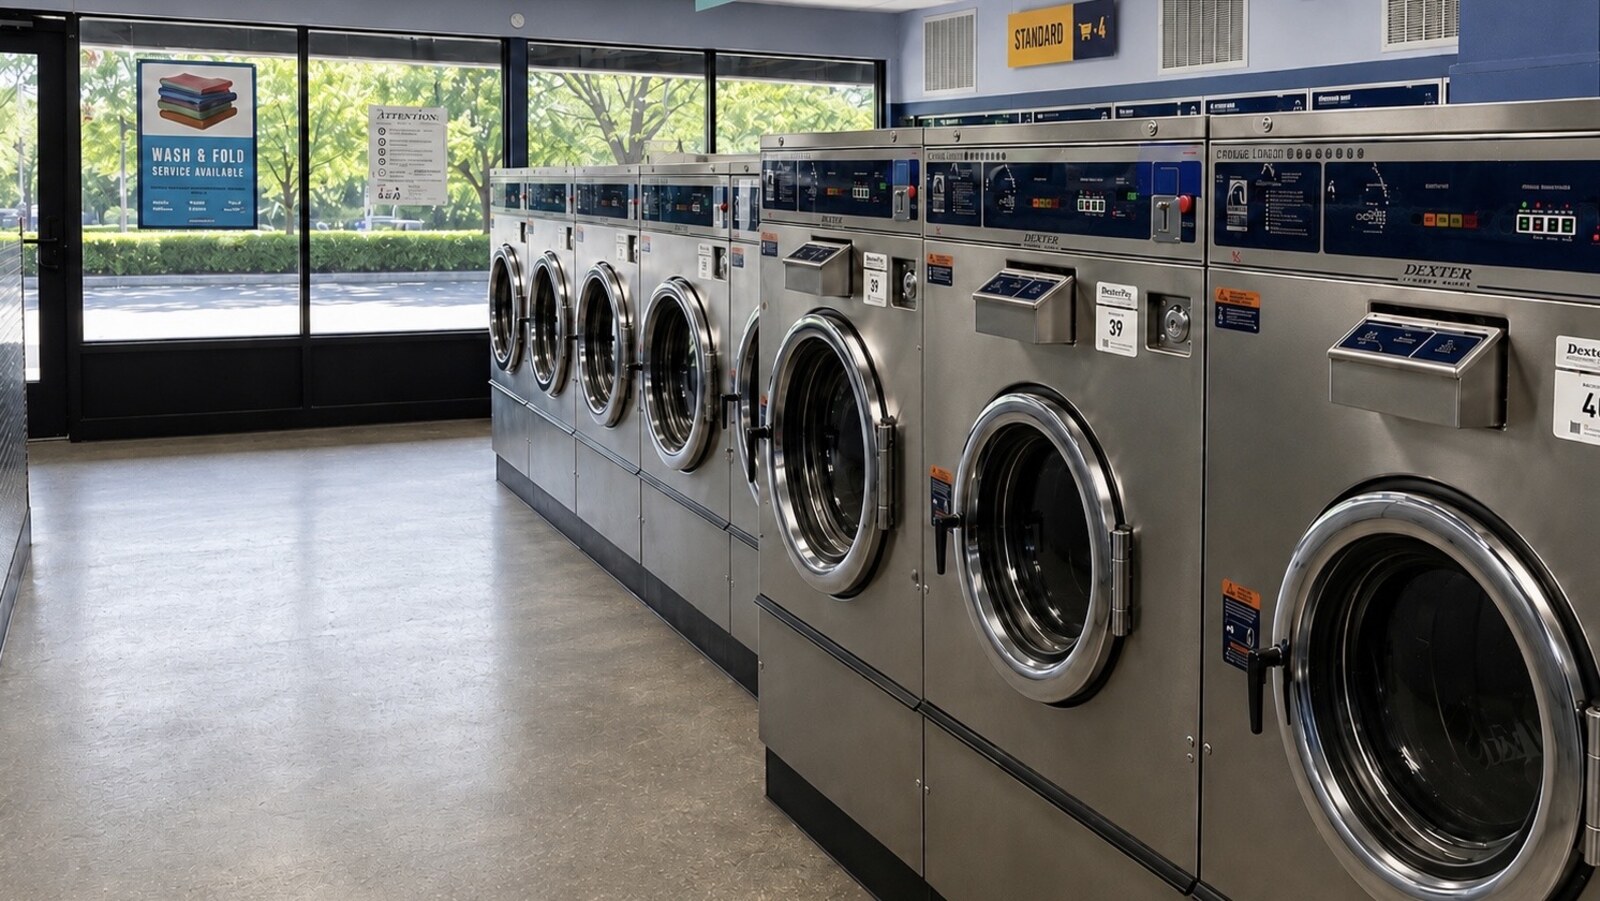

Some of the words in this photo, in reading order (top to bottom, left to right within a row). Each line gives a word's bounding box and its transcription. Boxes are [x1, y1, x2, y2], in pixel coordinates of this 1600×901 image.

[1014, 22, 1064, 50] STANDARD
[152, 147, 190, 162] WASH
[197, 148, 206, 163] &
[212, 149, 245, 163] FOLD
[152, 166, 191, 176] SERVICE
[194, 167, 244, 177] AVAILABLE
[1024, 233, 1059, 245] DEXTER
[1404, 263, 1472, 280] DEXTER
[870, 278, 879, 293] 39
[1109, 319, 1123, 337] 39
[1582, 392, 1600, 418] 4
